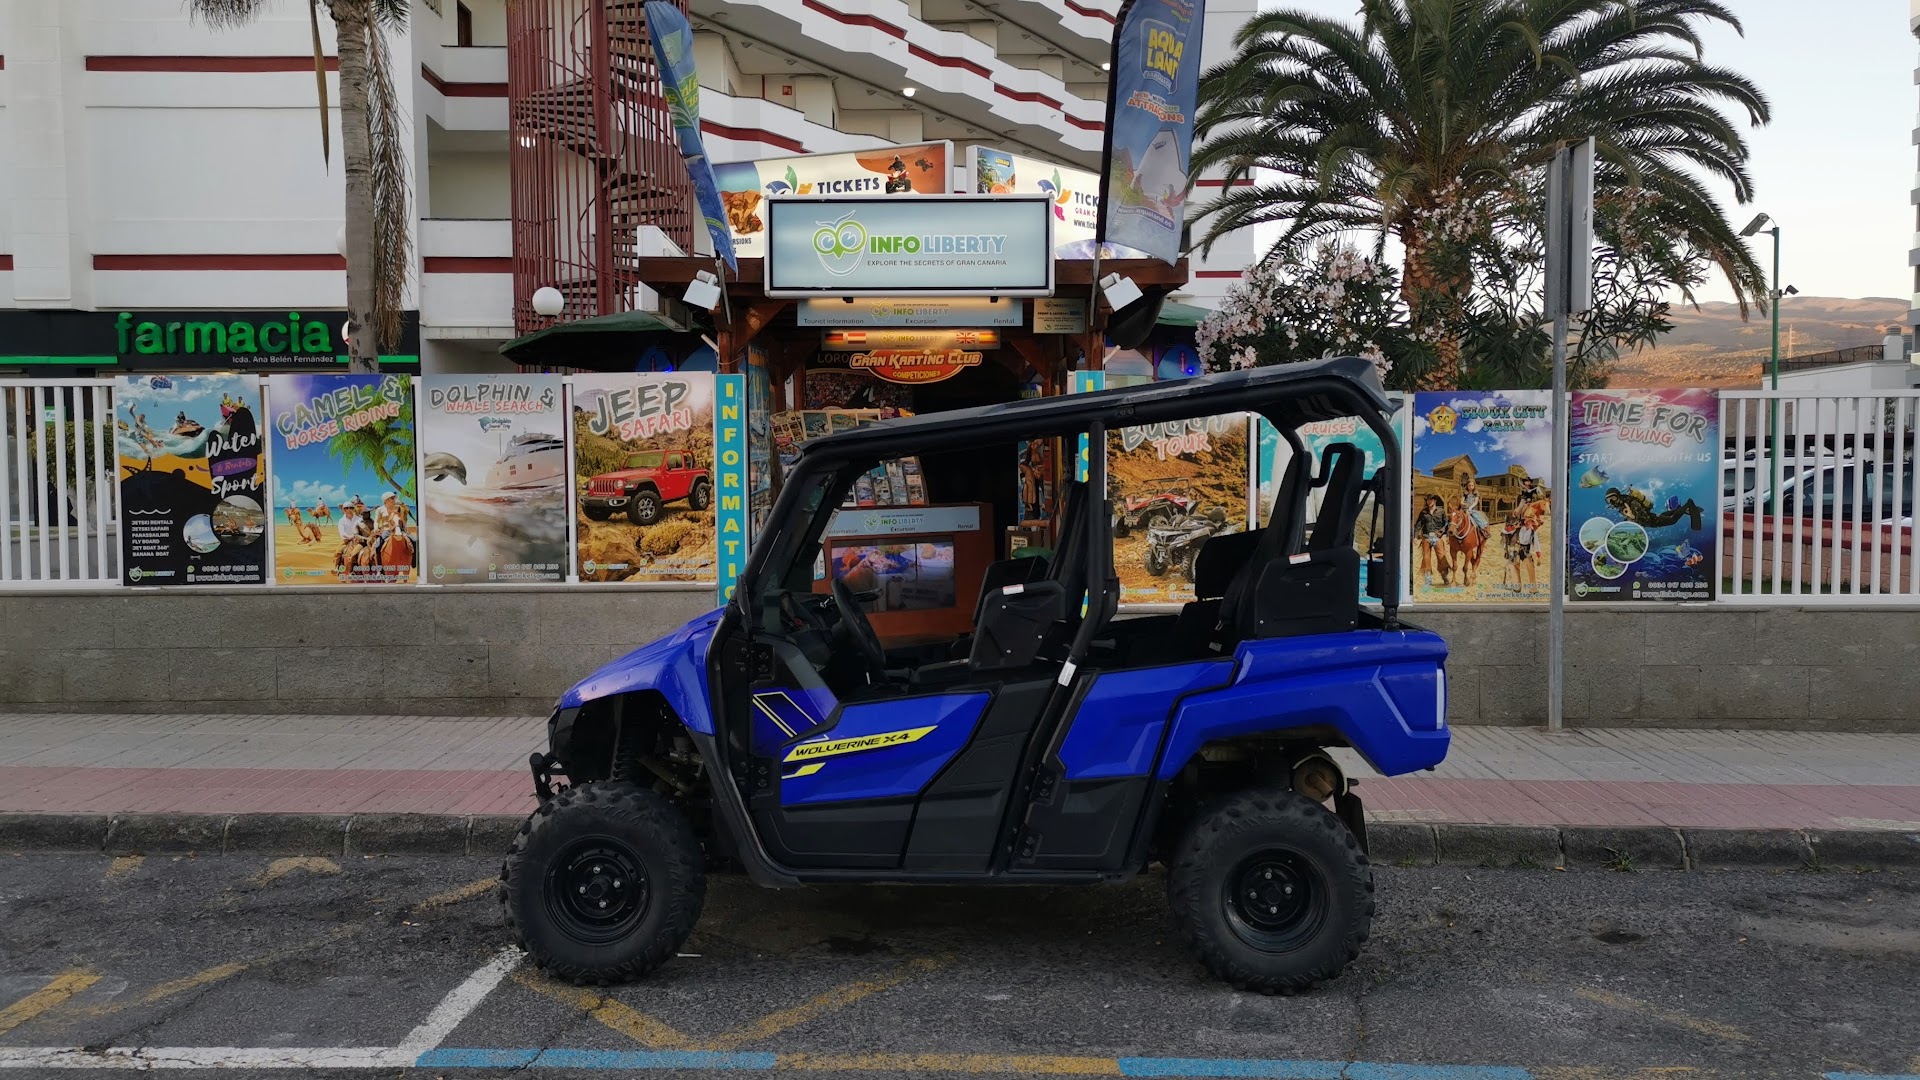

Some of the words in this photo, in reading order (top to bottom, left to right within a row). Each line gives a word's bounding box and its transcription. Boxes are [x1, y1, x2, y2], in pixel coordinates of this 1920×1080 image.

[1148, 28, 1183, 61] AQUA
[818, 177, 880, 194] TICKETS
[1074, 191, 1099, 208] TICK
[1074, 219, 1097, 230] www.tick
[732, 238, 752, 246] RSIONS
[870, 235, 921, 254] INFO
[923, 235, 1007, 254] LIBERTY
[893, 308, 914, 316] INFO
[916, 308, 950, 316] LIBERTY
[114, 312, 333, 354] farmacia
[252, 356, 268, 364] Ana
[270, 356, 292, 364] Belén
[294, 356, 334, 364] Fernández
[817, 353, 849, 364] LORO
[892, 370, 941, 380] COMPETICIONES
[431, 384, 530, 406] DOLPHIN
[277, 385, 373, 436] CAMEL
[446, 401, 491, 412] WHALE
[495, 400, 544, 412] SEARCH
[590, 382, 687, 432] JEEP
[1462, 406, 1510, 419] SIOUX
[1512, 405, 1548, 418] CITY
[286, 420, 339, 449] HORSE
[342, 402, 400, 431] RIDING
[621, 410, 690, 439] SAFARI
[1303, 423, 1356, 435] CRUISES
[1482, 420, 1526, 432] PARK
[1584, 402, 1644, 424] TIME
[1652, 407, 1706, 441] FOR
[1620, 426, 1674, 445] DIVING
[206, 432, 261, 458] Water
[1152, 433, 1212, 460] TOUR
[1579, 453, 1614, 464] START
[1697, 453, 1712, 462] US
[212, 472, 260, 499] Sport
[883, 733, 911, 744] X4
